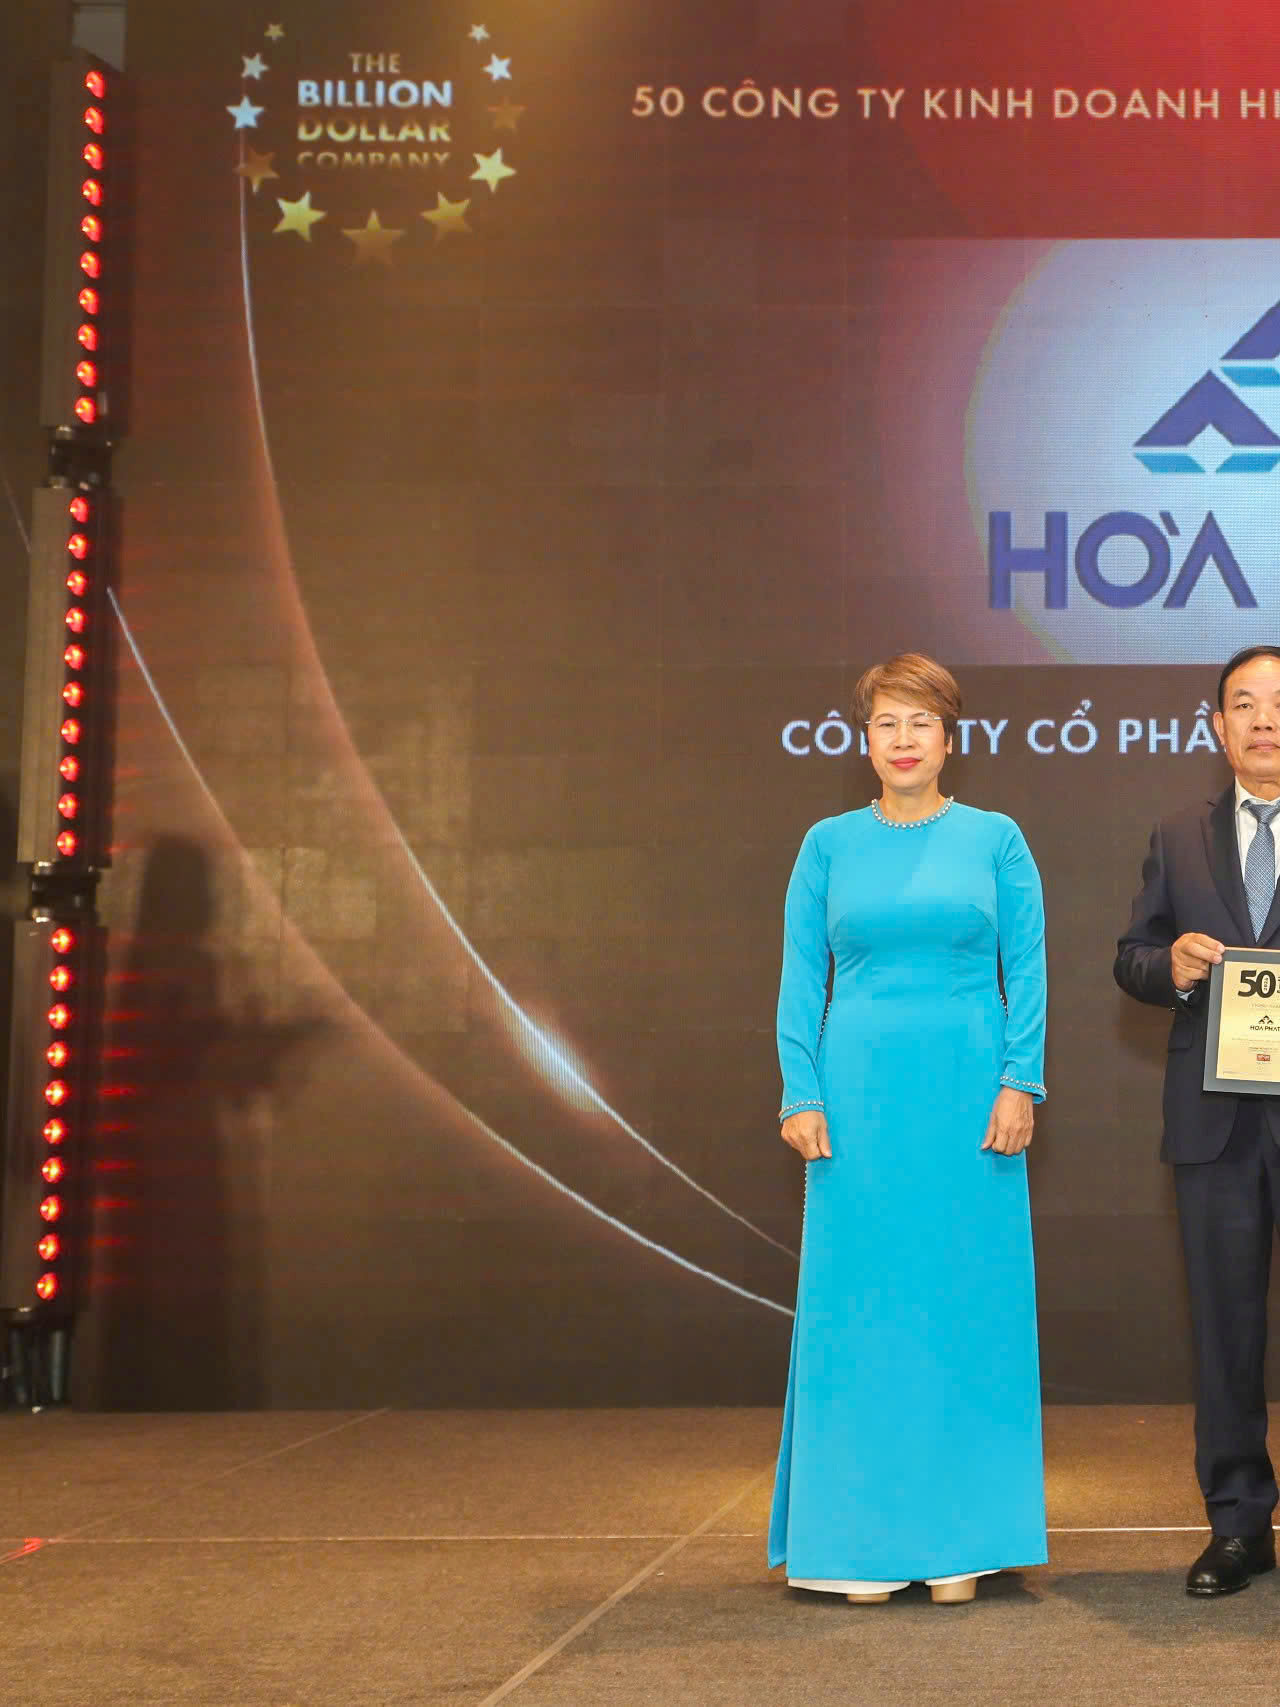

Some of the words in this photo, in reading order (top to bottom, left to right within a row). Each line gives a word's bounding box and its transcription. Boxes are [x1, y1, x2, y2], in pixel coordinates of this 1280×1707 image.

[349, 53, 400, 73] THE
[297, 80, 451, 107] BILLION
[631, 86, 684, 118] 50
[702, 79, 839, 118] CÔNG
[857, 88, 905, 119] TY
[923, 87, 1033, 119] KINH
[1053, 88, 1220, 119] DOANH
[297, 116, 450, 142] DOLLAR
[781, 710, 868, 756] CÔ
[957, 719, 1008, 755] TY
[1026, 699, 1098, 755] CỔ
[1118, 700, 1218, 753] PHẦ
[1238, 970, 1276, 998] 50
